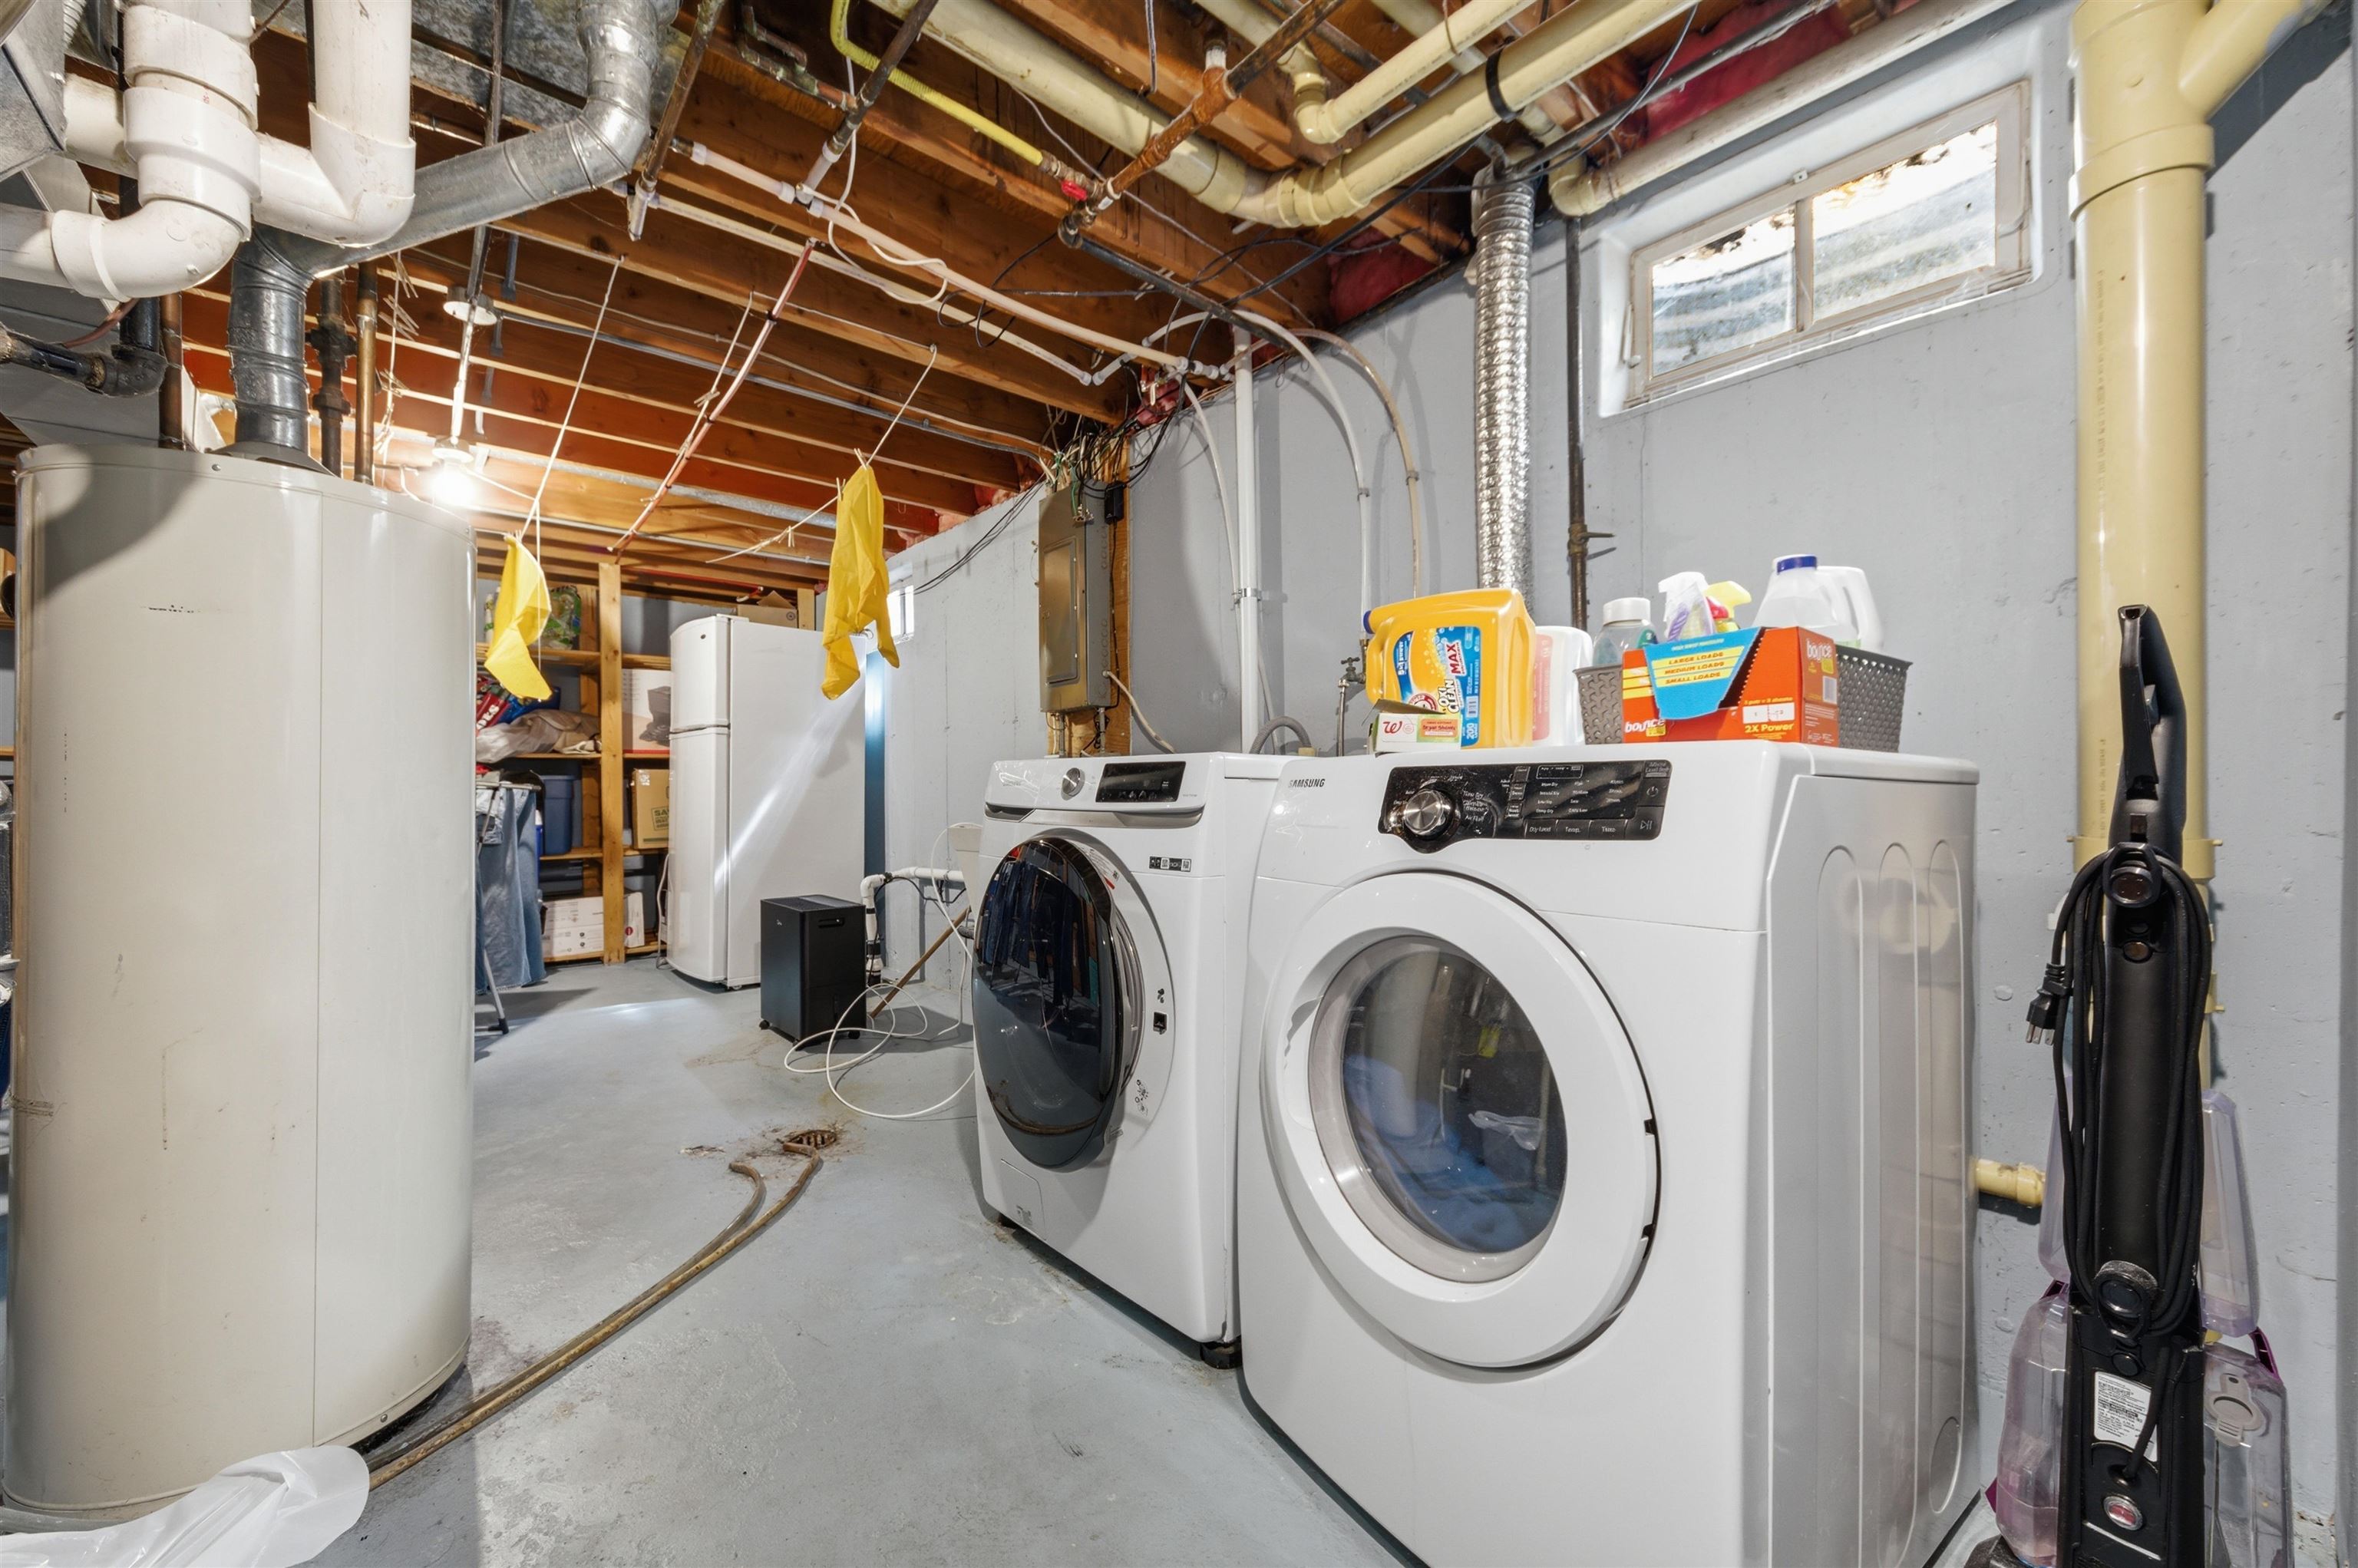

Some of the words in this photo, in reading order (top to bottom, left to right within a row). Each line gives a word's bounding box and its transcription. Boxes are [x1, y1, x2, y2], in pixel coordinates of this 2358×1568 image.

[1807, 639, 1832, 661] bounce
[1446, 644, 1461, 674] MAX
[1669, 657, 1695, 665] LARGE
[1696, 652, 1724, 661] LOADS
[1664, 666, 1696, 675] MEDIUM
[1697, 662, 1725, 670] LOADS
[1665, 676, 1692, 685] SMALL
[1693, 672, 1721, 681] LOADS
[1438, 687, 1450, 707] OXI
[1445, 679, 1461, 713] CLEAN
[1624, 718, 1666, 733] bounce
[1745, 725, 1759, 733] 2X
[1761, 723, 1794, 732] Power
[1289, 778, 1326, 787] SAMSUNG
